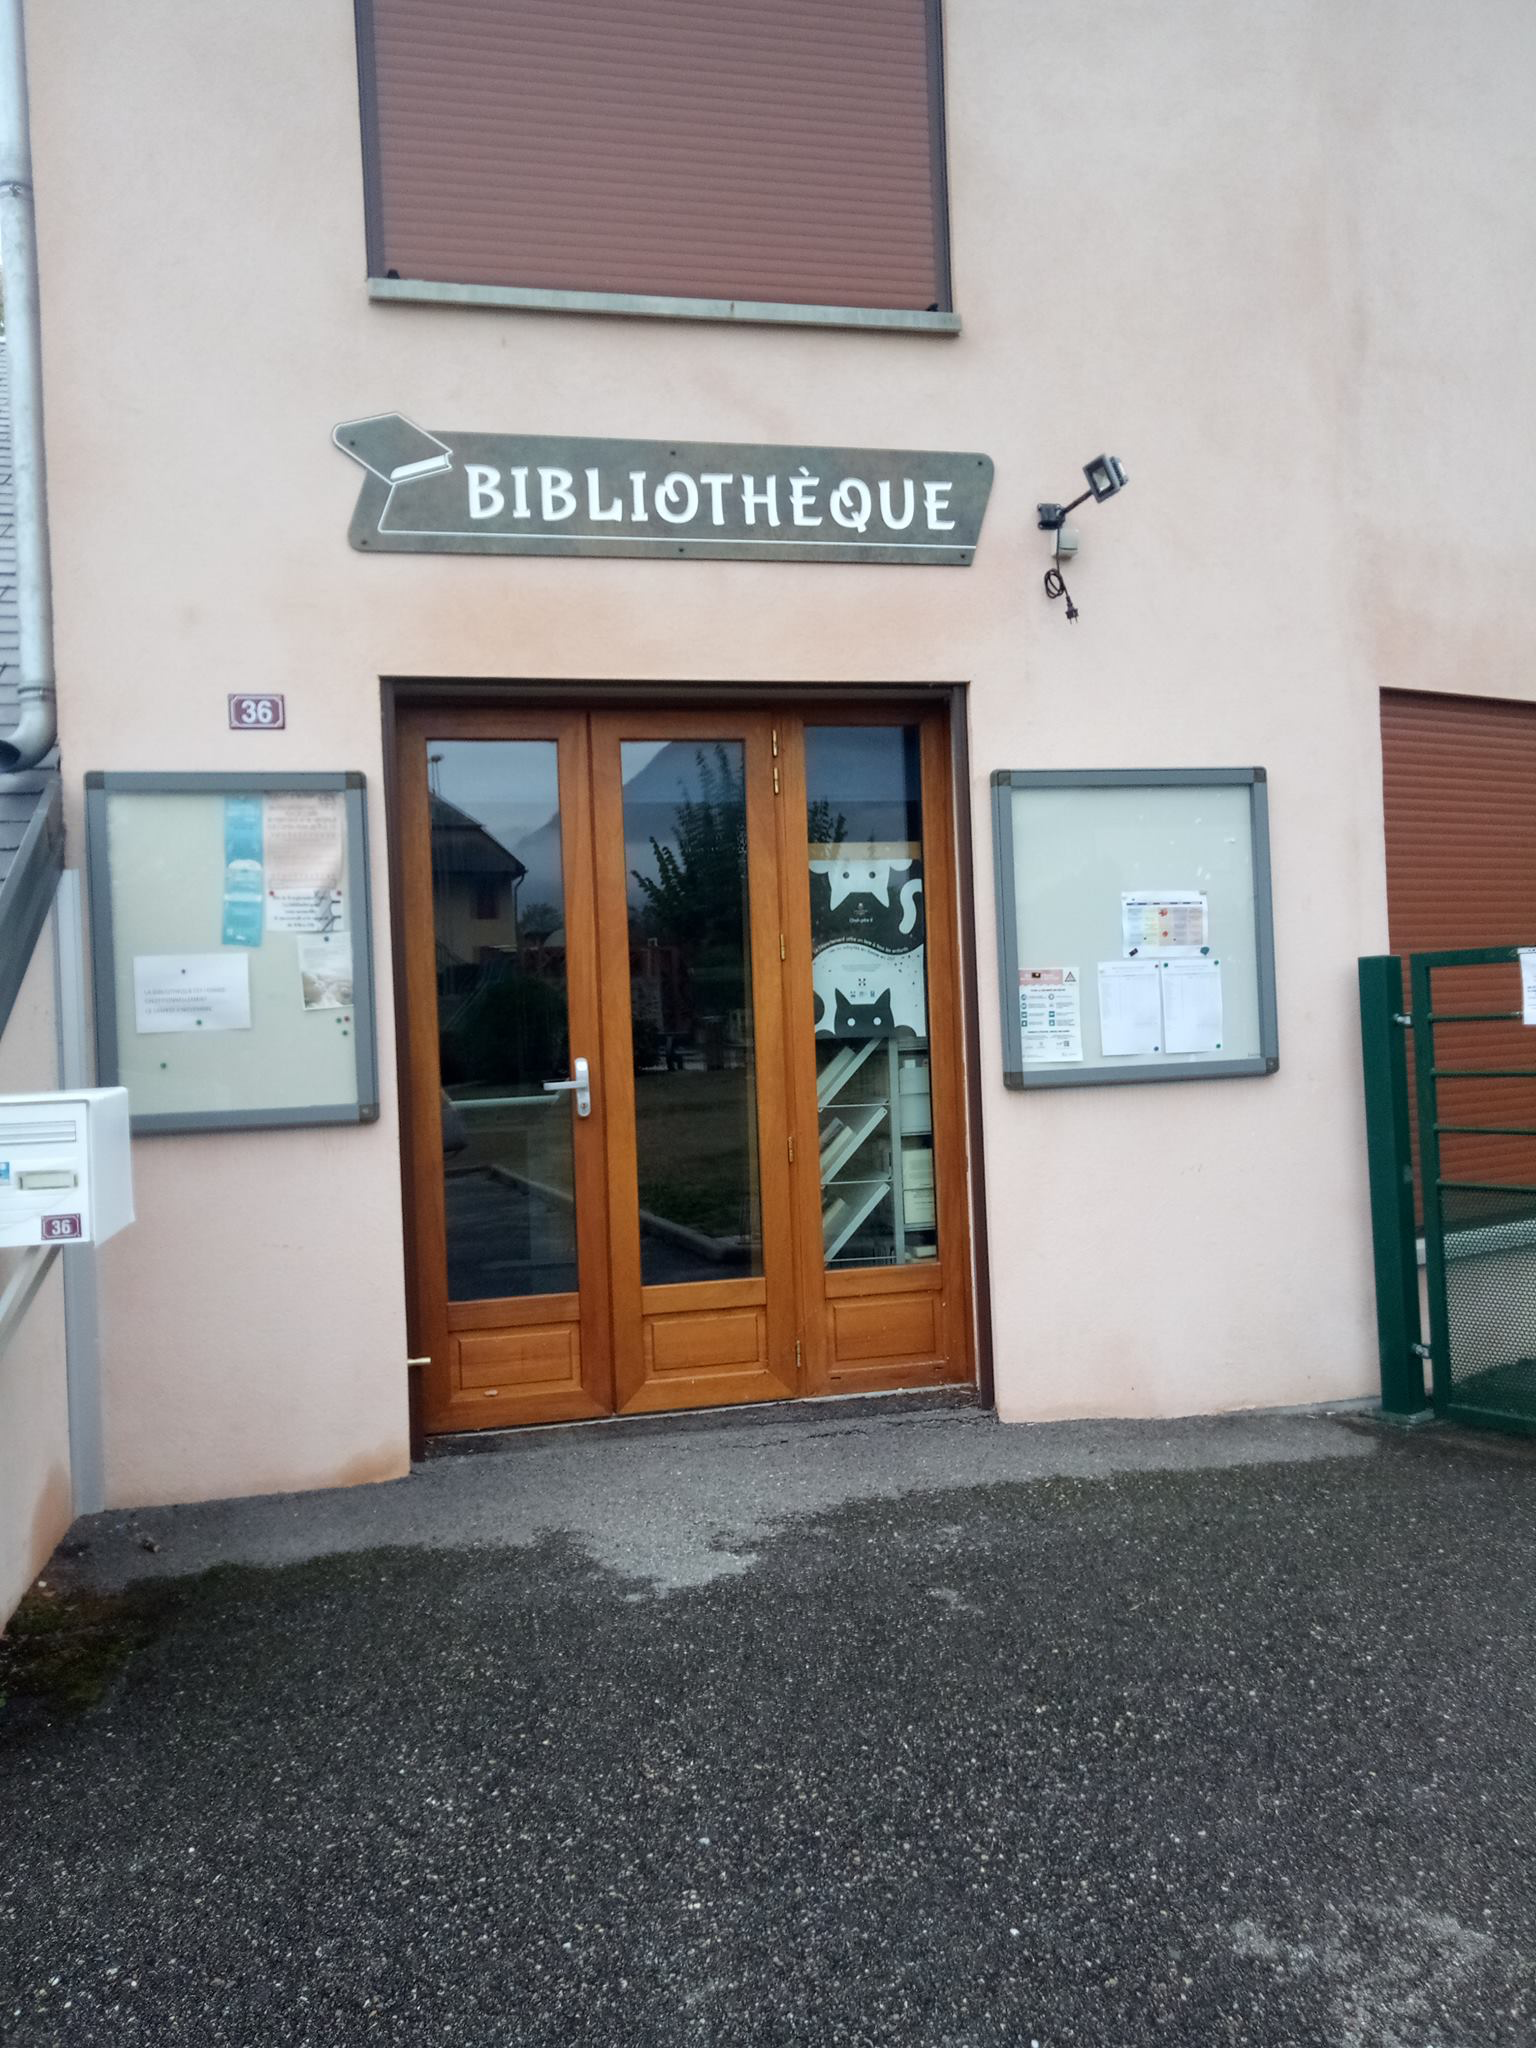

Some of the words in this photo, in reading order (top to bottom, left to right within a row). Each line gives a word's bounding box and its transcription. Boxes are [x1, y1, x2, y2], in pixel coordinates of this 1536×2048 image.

[464, 463, 956, 533] BIBLIOTHÈQUE
[241, 700, 273, 724] 36
[51, 1219, 72, 1236] 36
